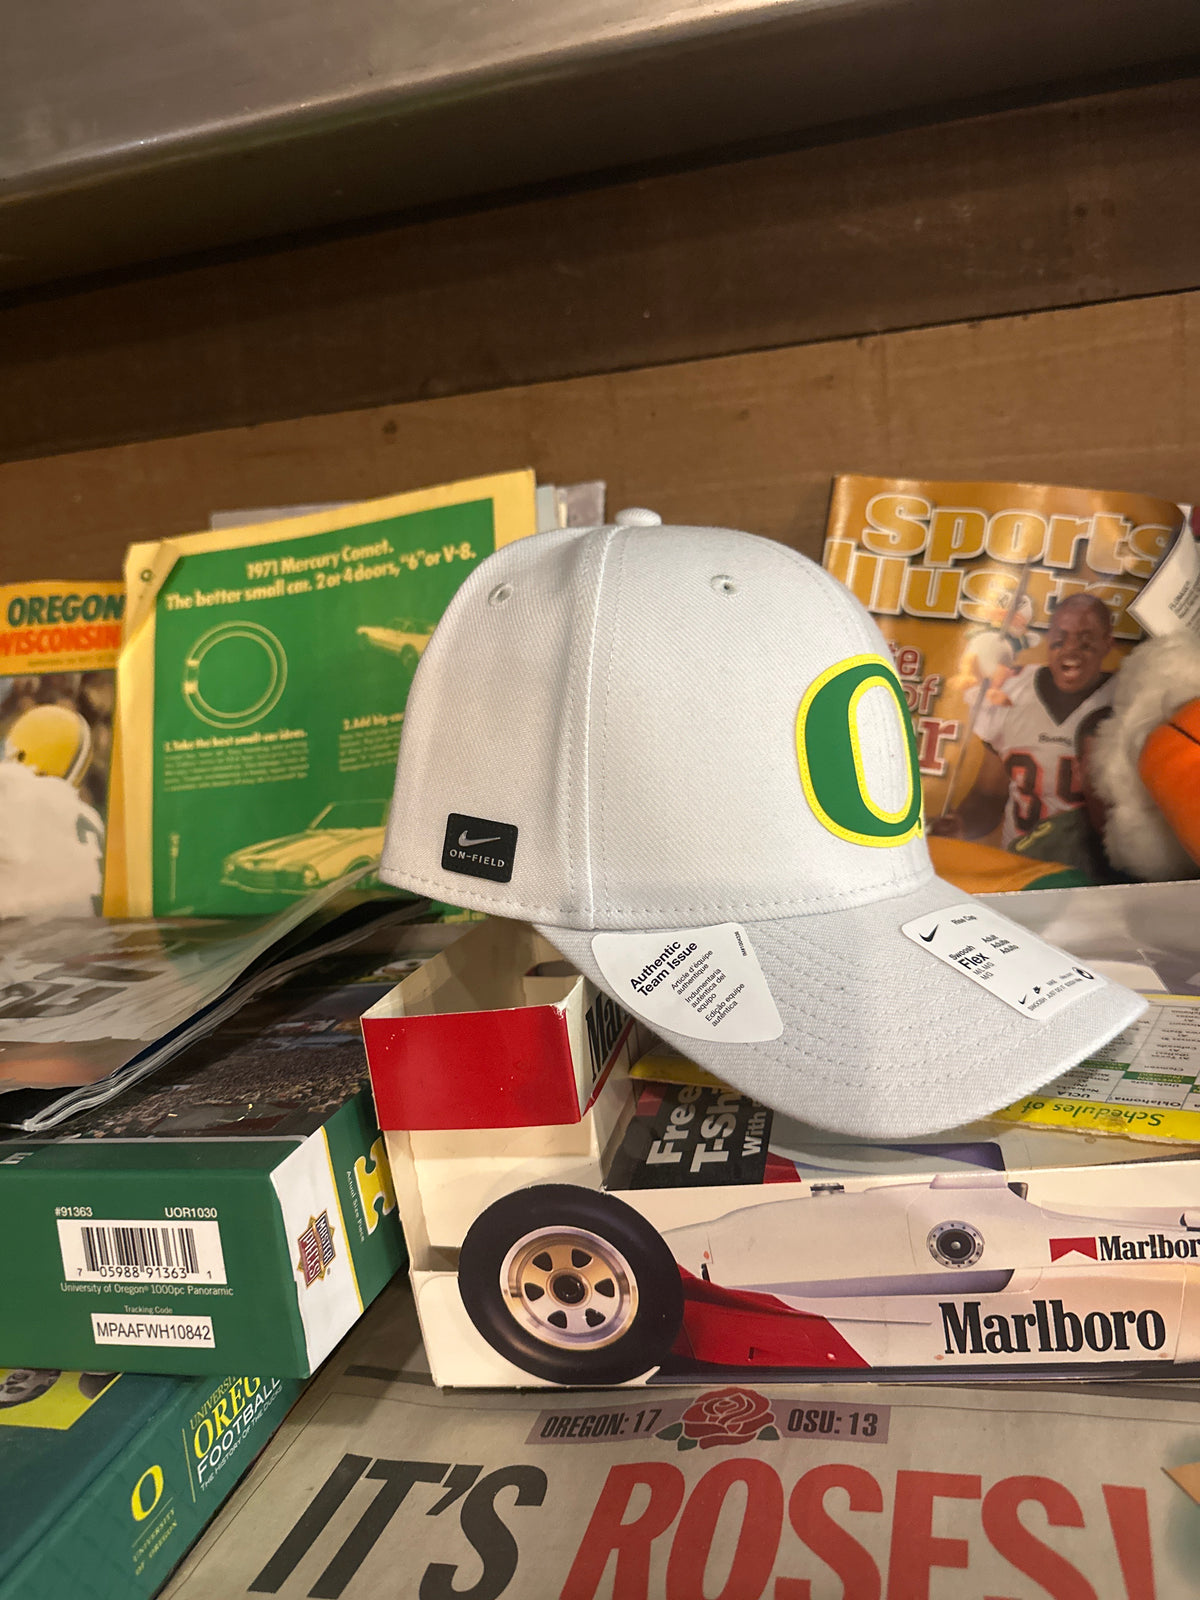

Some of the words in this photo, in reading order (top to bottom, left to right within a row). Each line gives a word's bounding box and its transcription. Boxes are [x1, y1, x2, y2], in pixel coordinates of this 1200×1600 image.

[862, 493, 1174, 580] Sports
[165, 592, 193, 611] The
[194, 588, 241, 608] better
[244, 578, 285, 601] small
[287, 579, 313, 595] car.
[315, 572, 326, 590] 2
[326, 573, 341, 587] or
[343, 567, 353, 583] 4
[354, 563, 400, 582] doors,
[425, 553, 441, 567] or
[442, 541, 477, 563] V-8.
[246, 559, 278, 580] 1971
[281, 553, 340, 575] Mercury
[341, 538, 394, 562] Comet.
[8, 594, 126, 628] OREGON
[449, 848, 505, 868] ON-FIELD
[630, 940, 682, 990] Authentic
[636, 968, 670, 997] Team
[669, 941, 698, 970] Issue
[671, 971, 691, 991] Article
[689, 949, 714, 973] d'équipe
[948, 944, 976, 960] Swoosh
[957, 952, 990, 970] Flex
[676, 963, 709, 996] authentique
[684, 968, 722, 1004] Indumentaria
[716, 973, 727, 985] del
[697, 992, 717, 1014] equipo
[705, 1001, 727, 1023] Edição
[725, 982, 746, 1004] equipe
[1022, 1101, 1044, 1114] of
[1052, 1103, 1165, 1127] Schedules
[1057, 1091, 1091, 1099] UCLA
[1114, 1097, 1181, 1108] Oklahoma
[645, 1085, 702, 1165] Free
[690, 1088, 743, 1172] T-Sh
[742, 1112, 767, 1157] With
[55, 1206, 93, 1217] #91363
[165, 1207, 218, 1218] UOR1030
[302, 1231, 321, 1278] PIECES
[316, 1217, 335, 1264] MASTER
[60, 1282, 101, 1294] University
[103, 1283, 112, 1293] of
[151, 1285, 185, 1296] 1000pc
[187, 1285, 234, 1296] Panoramic
[77, 1268, 83, 1277] 7
[99, 1266, 140, 1278] 05988
[146, 1267, 187, 1279] 91363
[124, 1305, 154, 1315] Tracking
[154, 1306, 173, 1314] Code
[938, 1299, 1167, 1355] Marlboro
[96, 1322, 212, 1341] MPAAFWH10842
[197, 1378, 281, 1484] FOOTBALL
[200, 1472, 214, 1491] THE
[215, 1436, 241, 1475] HISTORY
[241, 1425, 251, 1439] OF
[251, 1409, 264, 1427] THE
[263, 1384, 283, 1411] DUCKS
[540, 1412, 630, 1439] OREGON:
[631, 1408, 663, 1434] 17
[787, 1408, 842, 1435] OSU:
[848, 1411, 879, 1437] 13
[131, 1464, 164, 1521] O
[132, 1506, 175, 1563] UNIVERSITY
[247, 1453, 548, 1600] IT'S
[558, 1457, 1157, 1600] ROSES!
[135, 1560, 145, 1576] OF
[148, 1520, 178, 1558] OREGON
